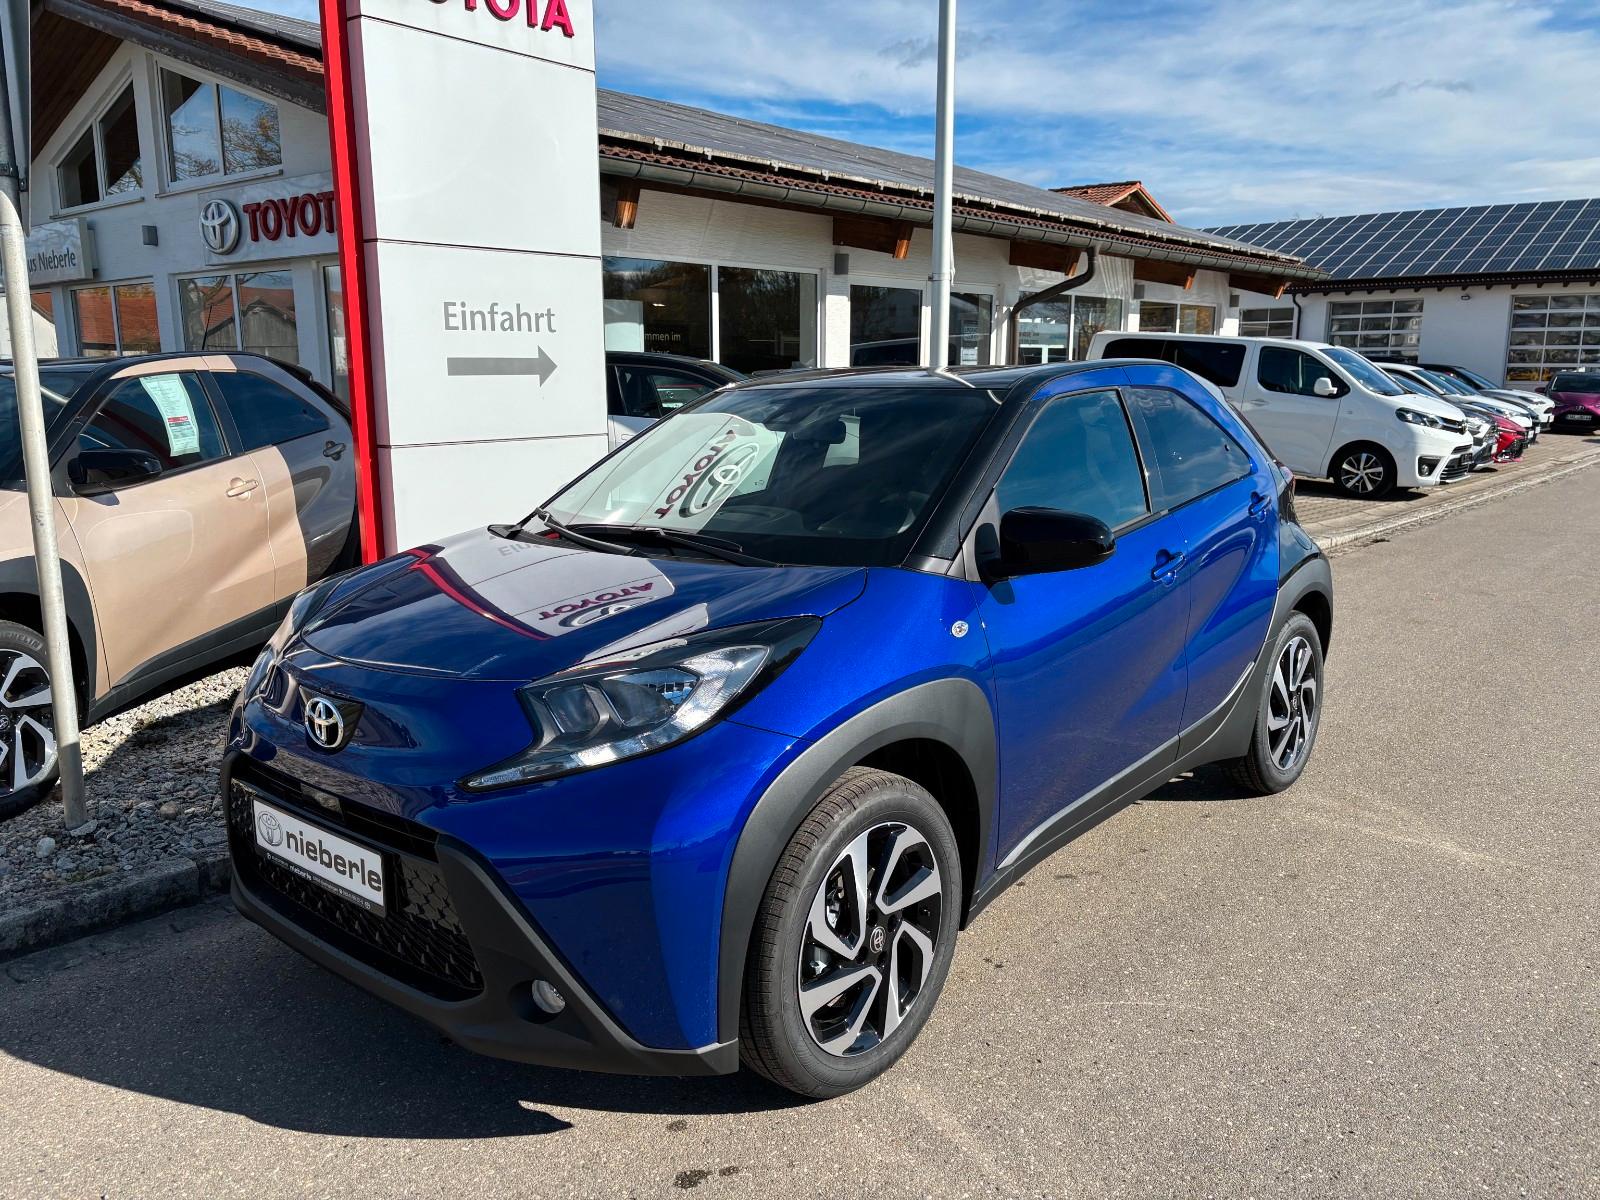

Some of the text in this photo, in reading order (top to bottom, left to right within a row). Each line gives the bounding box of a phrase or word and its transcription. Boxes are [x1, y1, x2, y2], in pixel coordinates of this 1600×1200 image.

[243, 191, 335, 242] TOYOT
[38, 247, 76, 271] Nieberle
[443, 301, 557, 333] Einfahrt
[286, 830, 382, 892] nieberle
